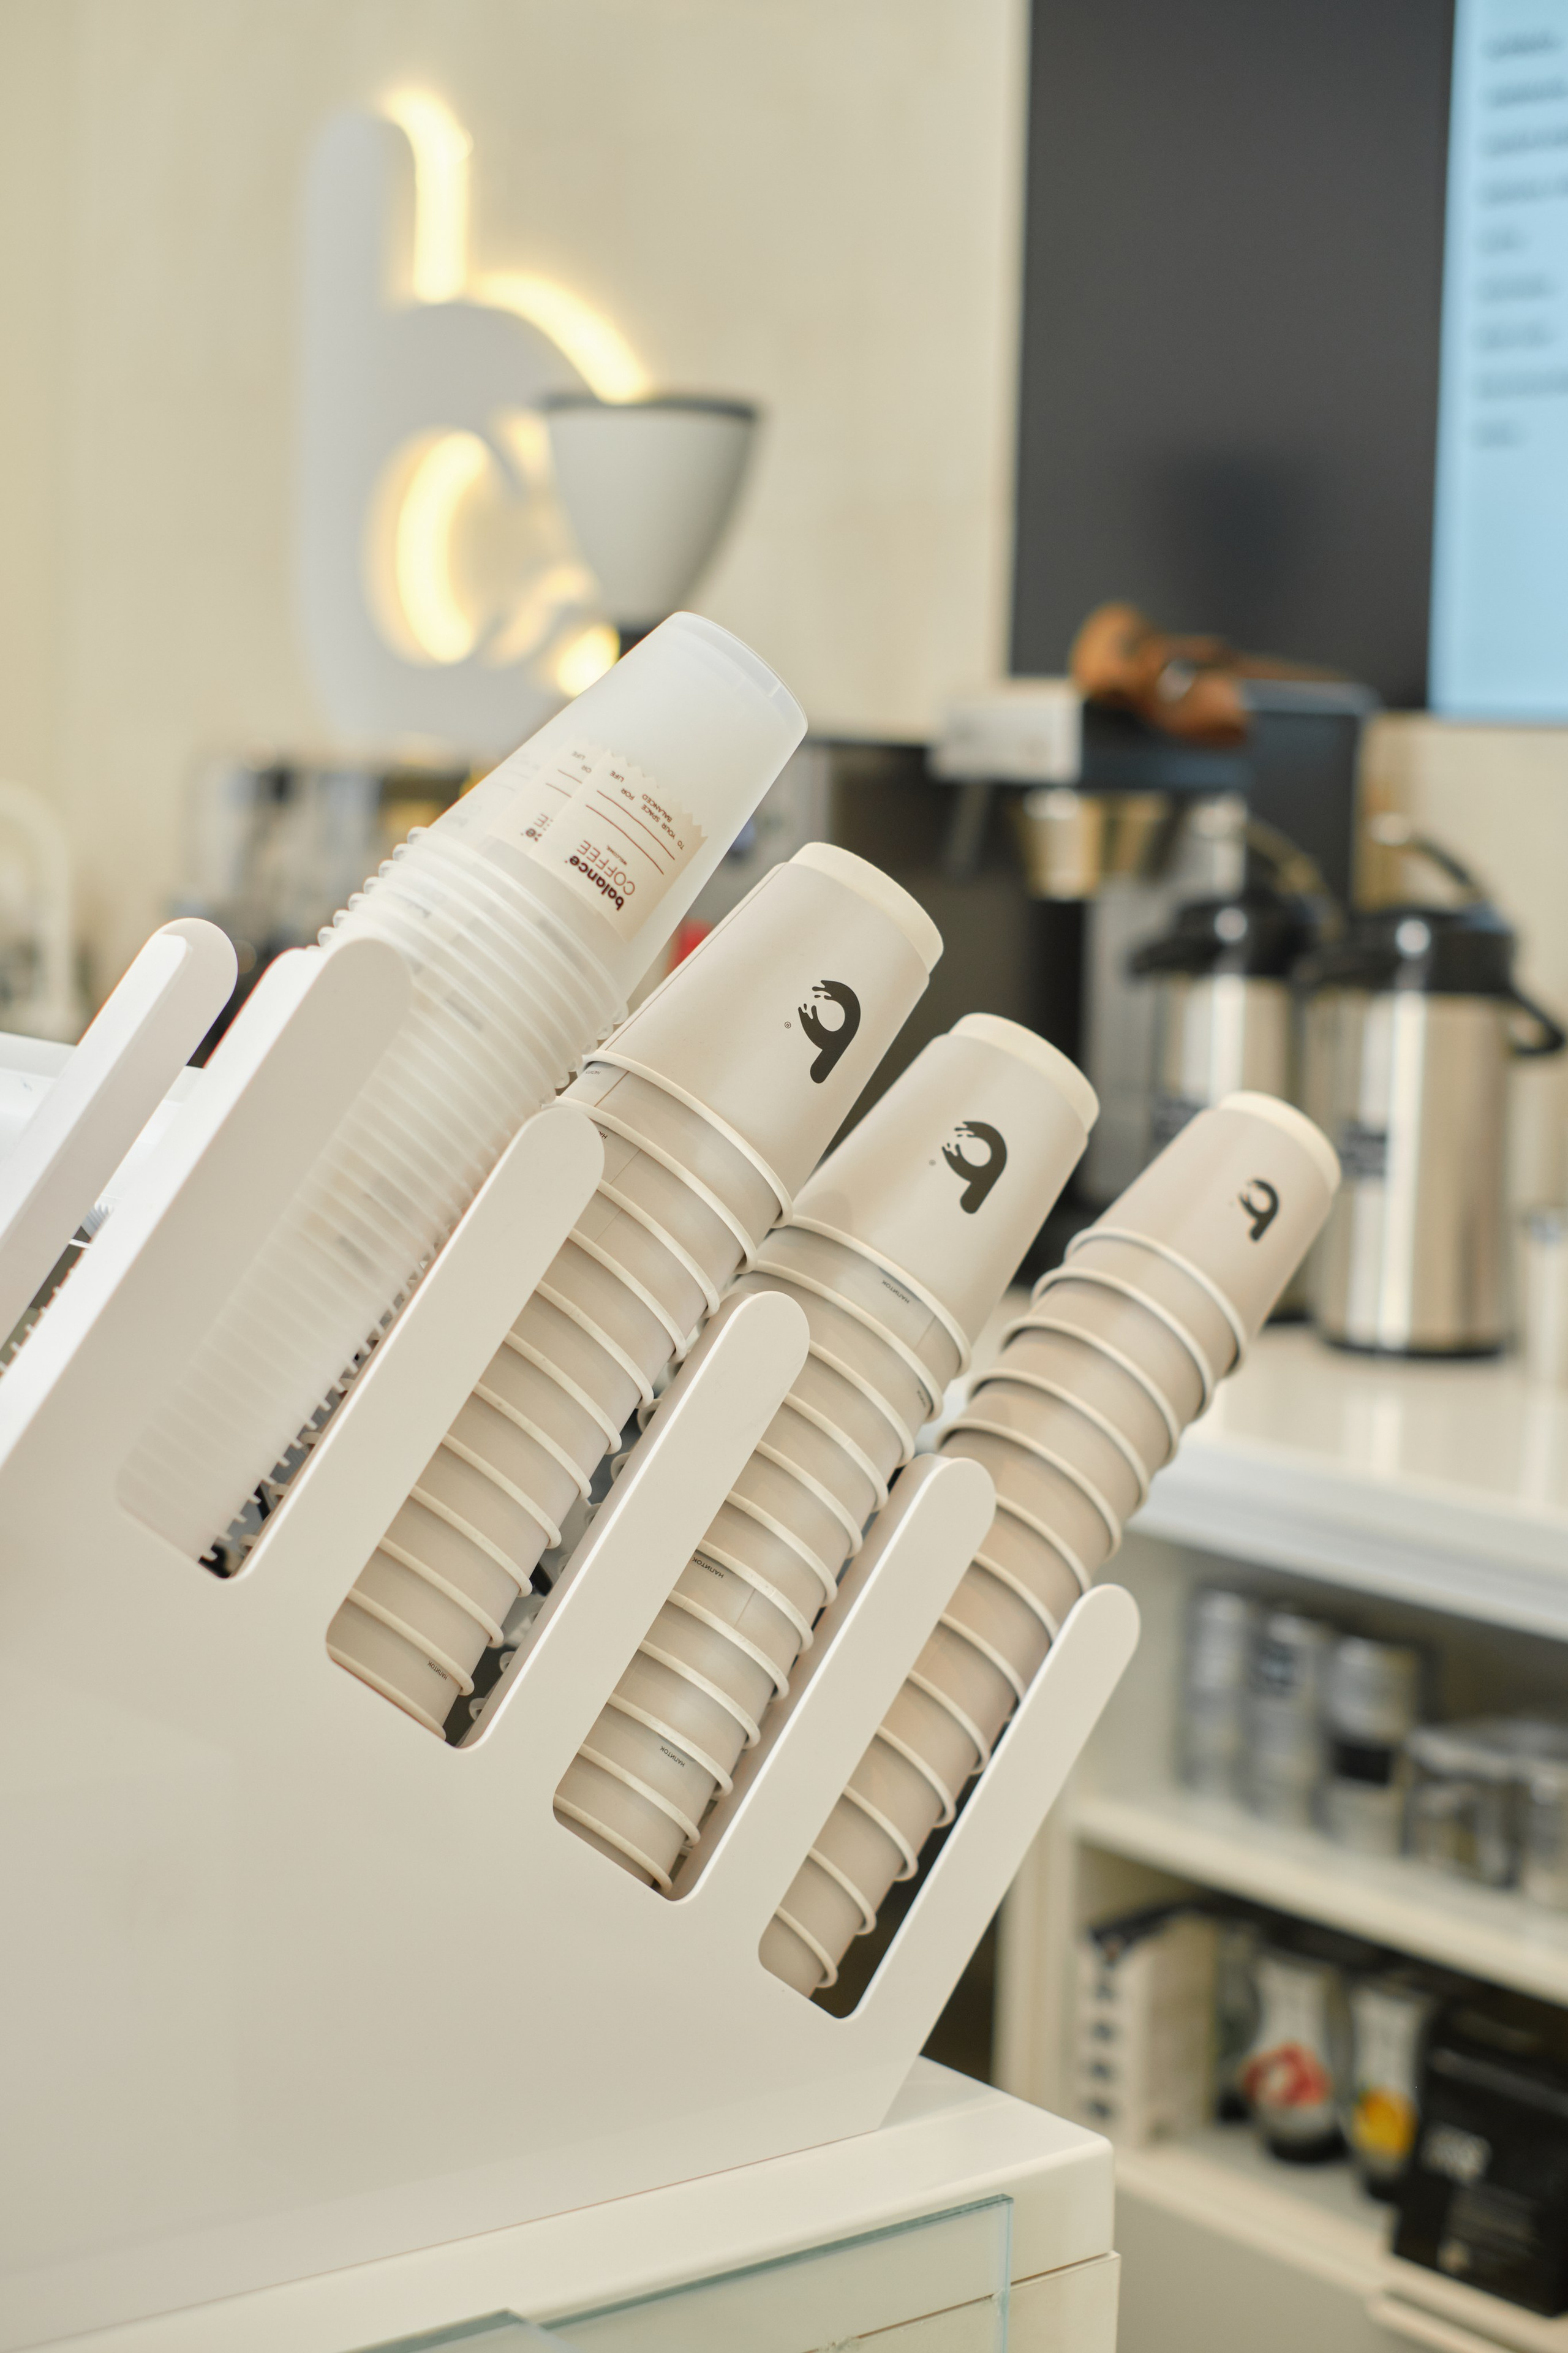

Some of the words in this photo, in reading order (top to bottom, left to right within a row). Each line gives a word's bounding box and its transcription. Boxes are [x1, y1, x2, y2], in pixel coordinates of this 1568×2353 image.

[609, 771, 625, 783] LIFE
[620, 788, 635, 801] FOR
[641, 793, 673, 823] BALANCED
[641, 804, 660, 823] SPACE
[661, 823, 676, 839] YOUR
[677, 840, 685, 850] TO
[576, 840, 635, 896] COFFEE
[569, 856, 625, 911] balance
[882, 1280, 910, 1304] НАПИТОК
[692, 1557, 724, 1579] НАПИТОК
[427, 1661, 448, 1680] НАПИТОК
[660, 1746, 685, 1767] НАПИТОК
